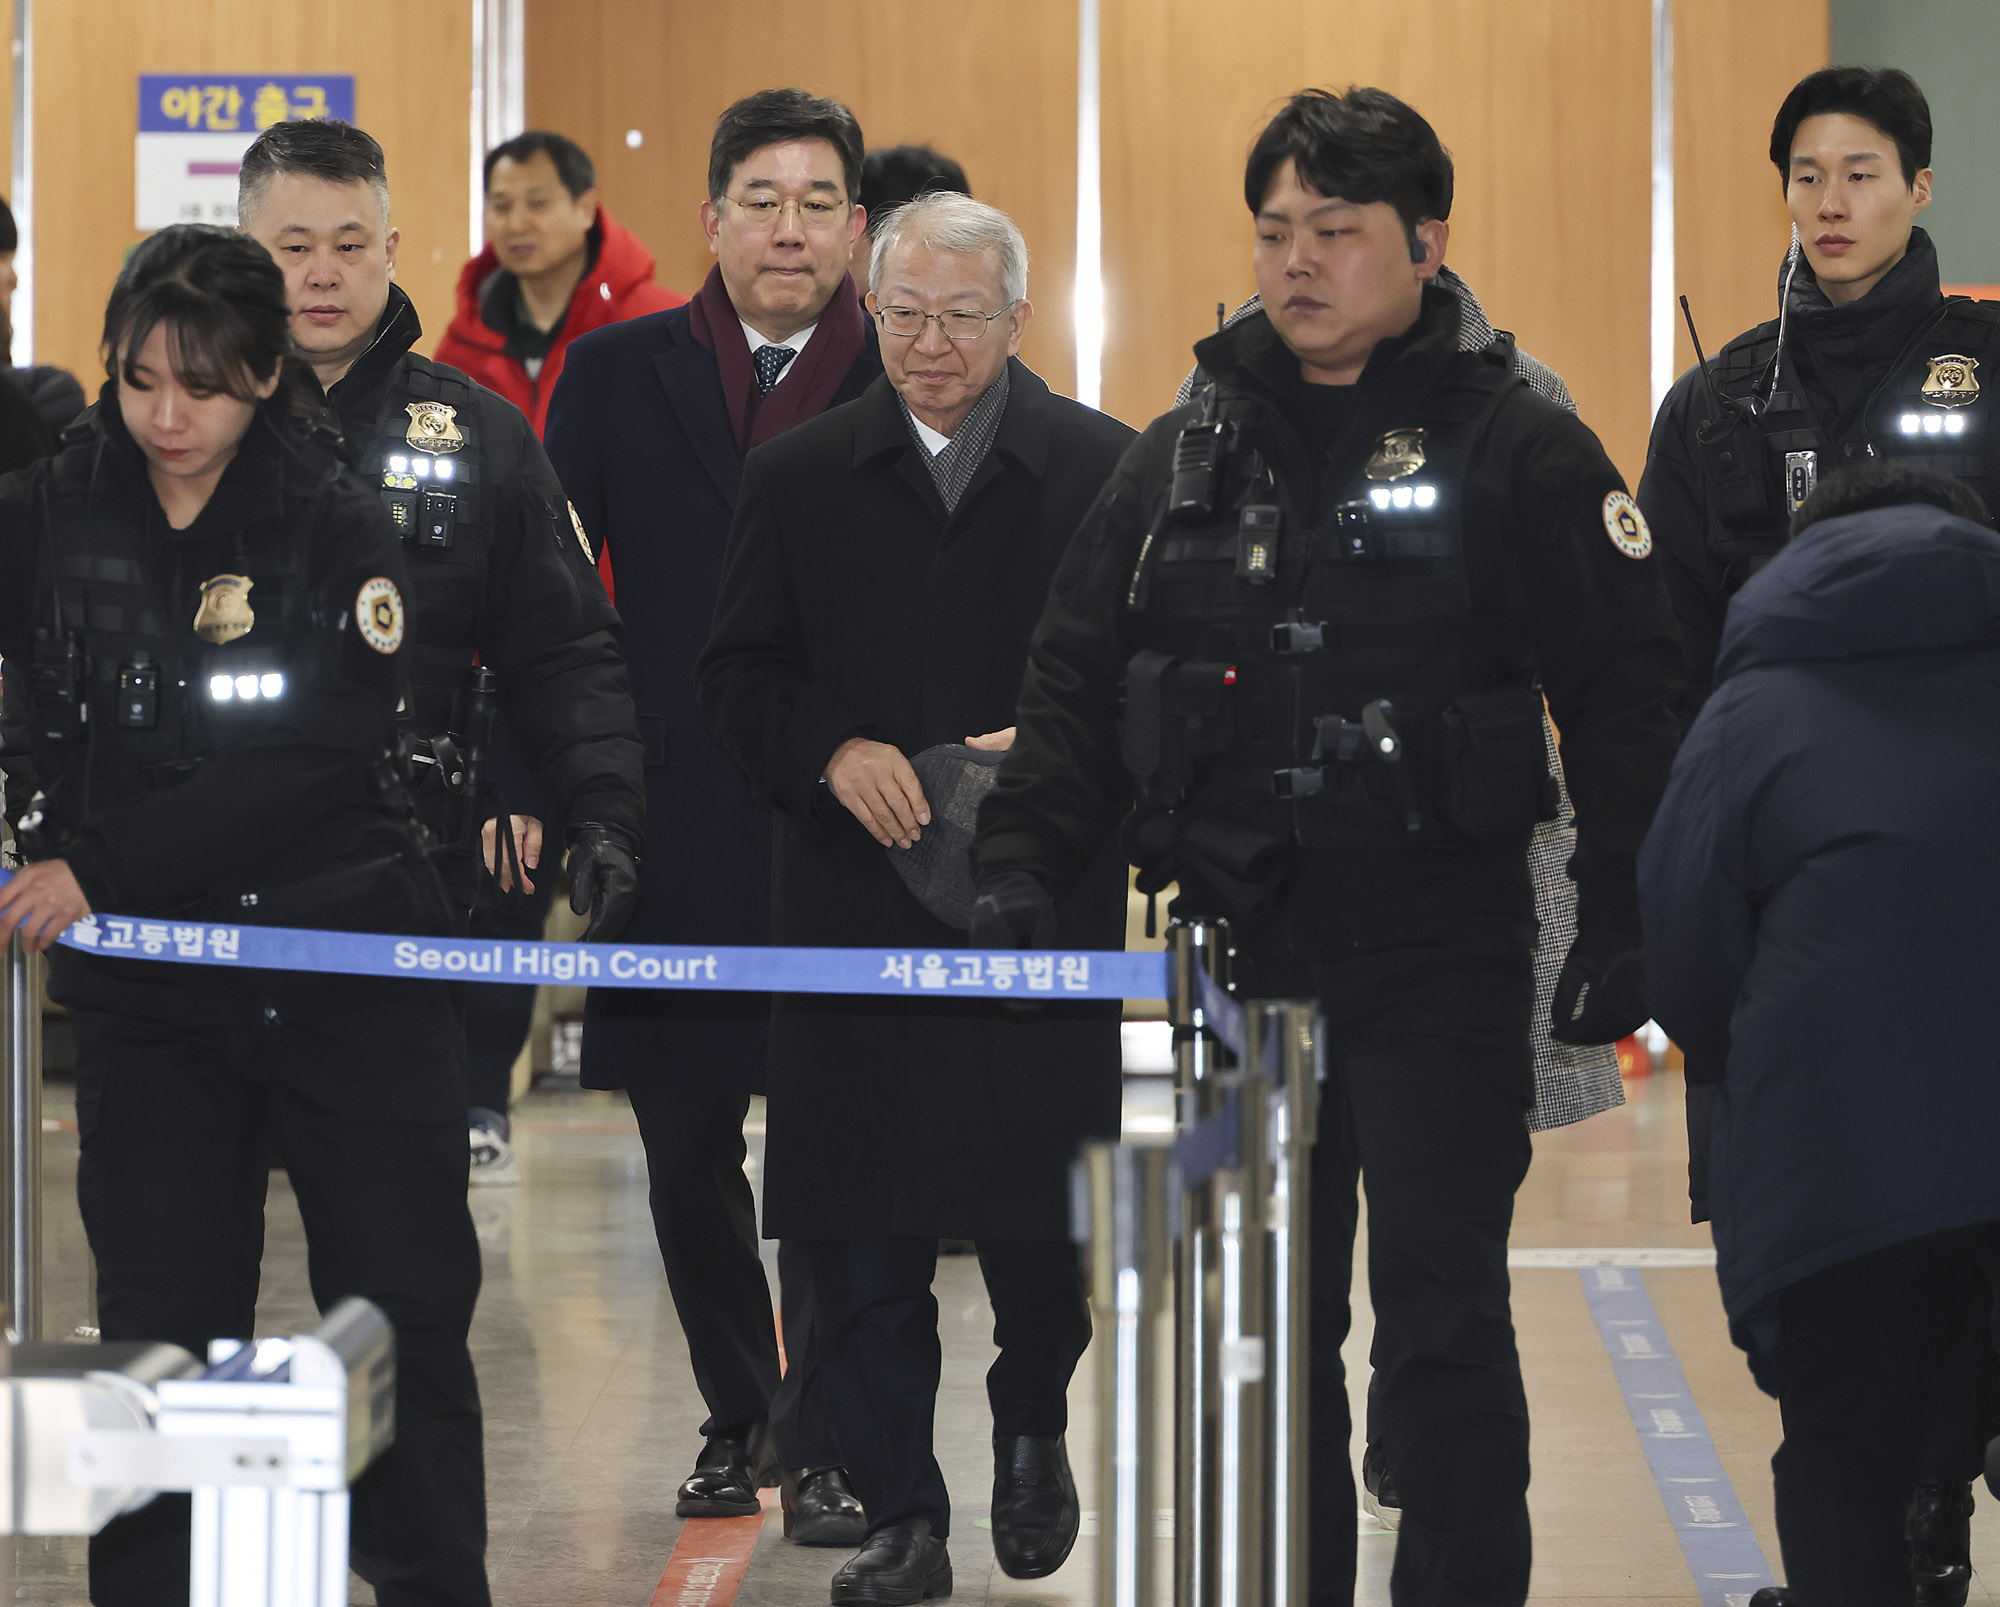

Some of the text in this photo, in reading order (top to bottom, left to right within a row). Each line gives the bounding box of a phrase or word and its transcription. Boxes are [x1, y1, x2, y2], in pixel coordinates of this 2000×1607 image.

[60, 913, 240, 959] 울고등법원
[394, 942, 718, 981] Seoul High Court
[880, 953, 1090, 991] 서울고등법원
